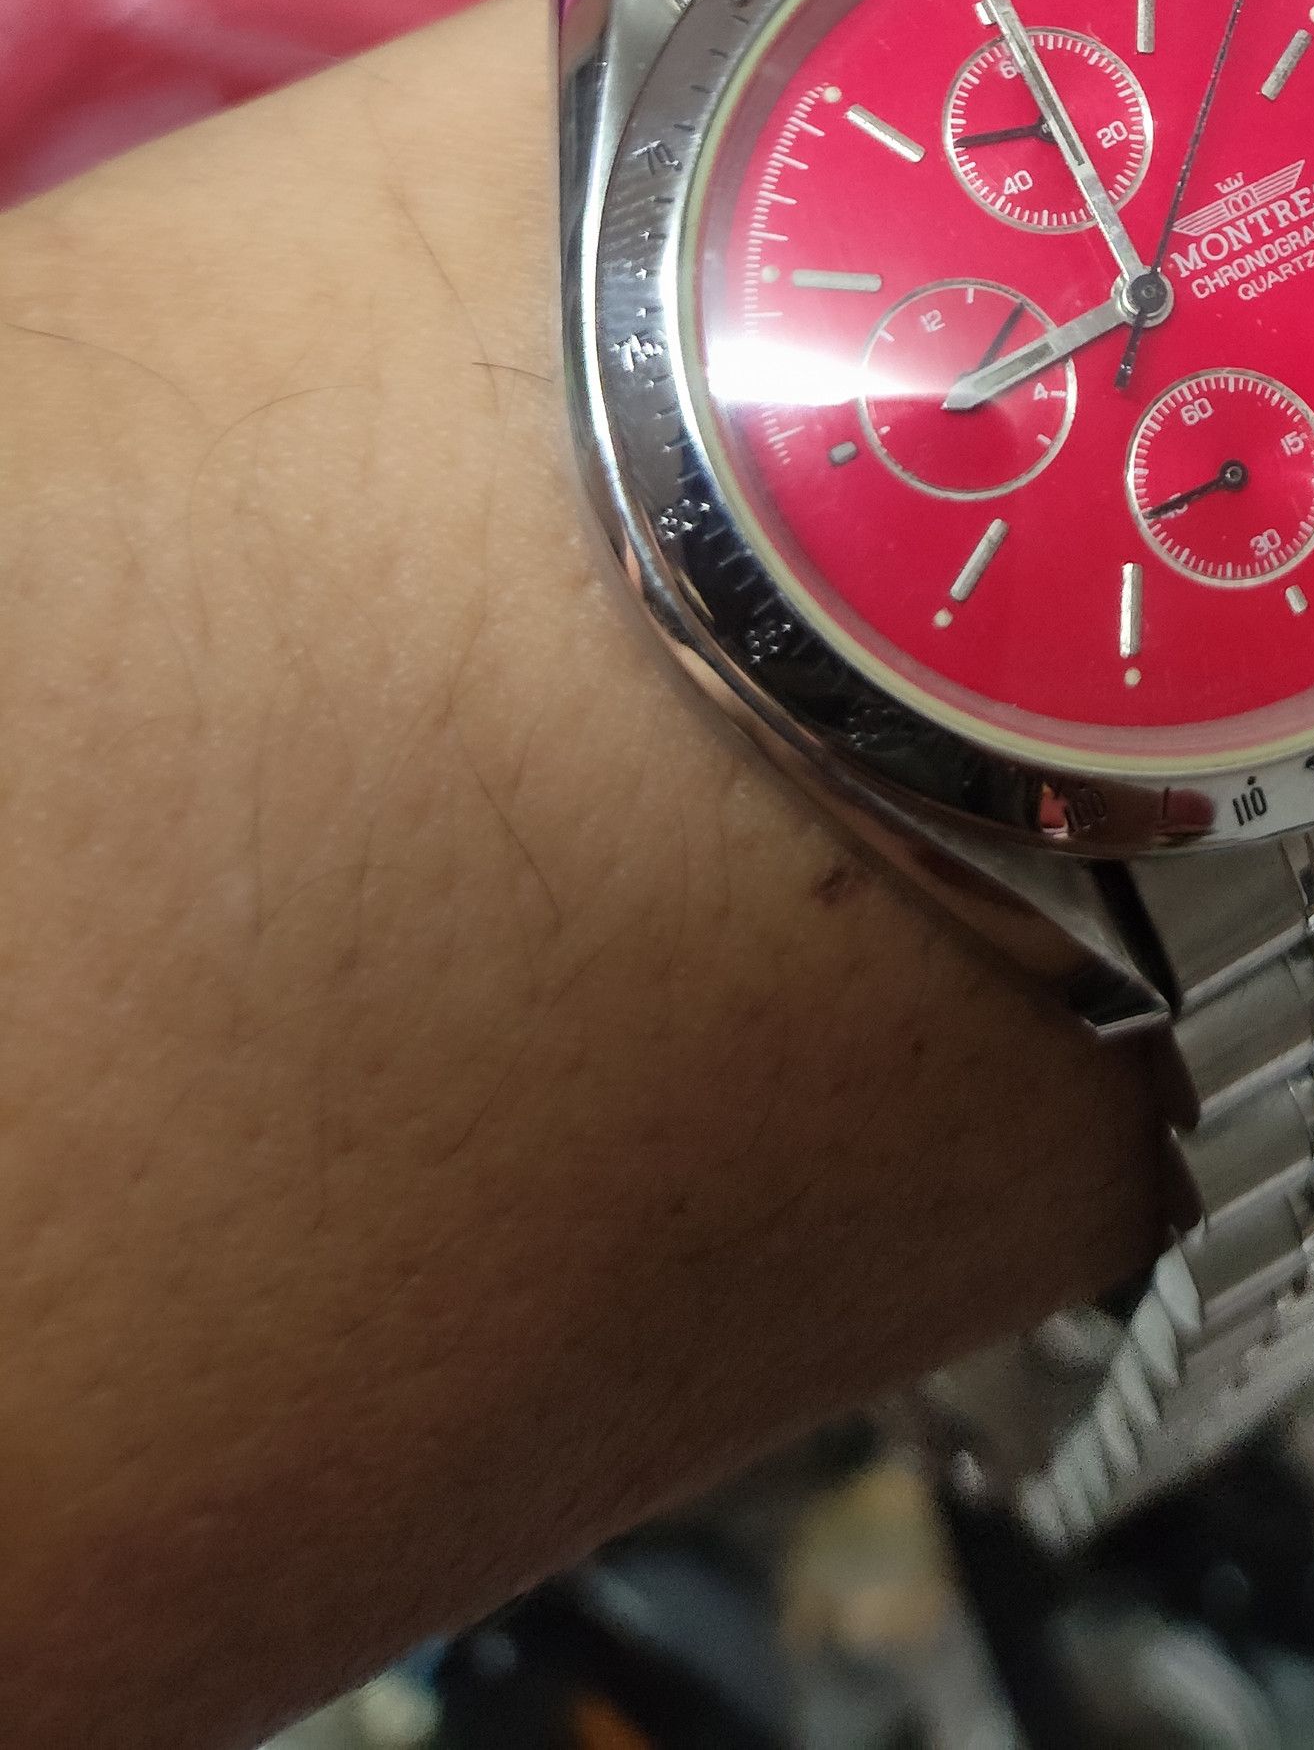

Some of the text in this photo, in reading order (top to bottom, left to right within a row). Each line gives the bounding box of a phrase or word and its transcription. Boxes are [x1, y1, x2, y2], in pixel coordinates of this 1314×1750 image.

[1096, 119, 1129, 150] 20
[1002, 169, 1034, 196] 40
[919, 308, 946, 333] 12
[1032, 381, 1049, 401] 4
[1179, 397, 1215, 427] 60
[1279, 430, 1308, 457] 15
[1250, 527, 1283, 557] 30
[1231, 785, 1269, 828] 110
